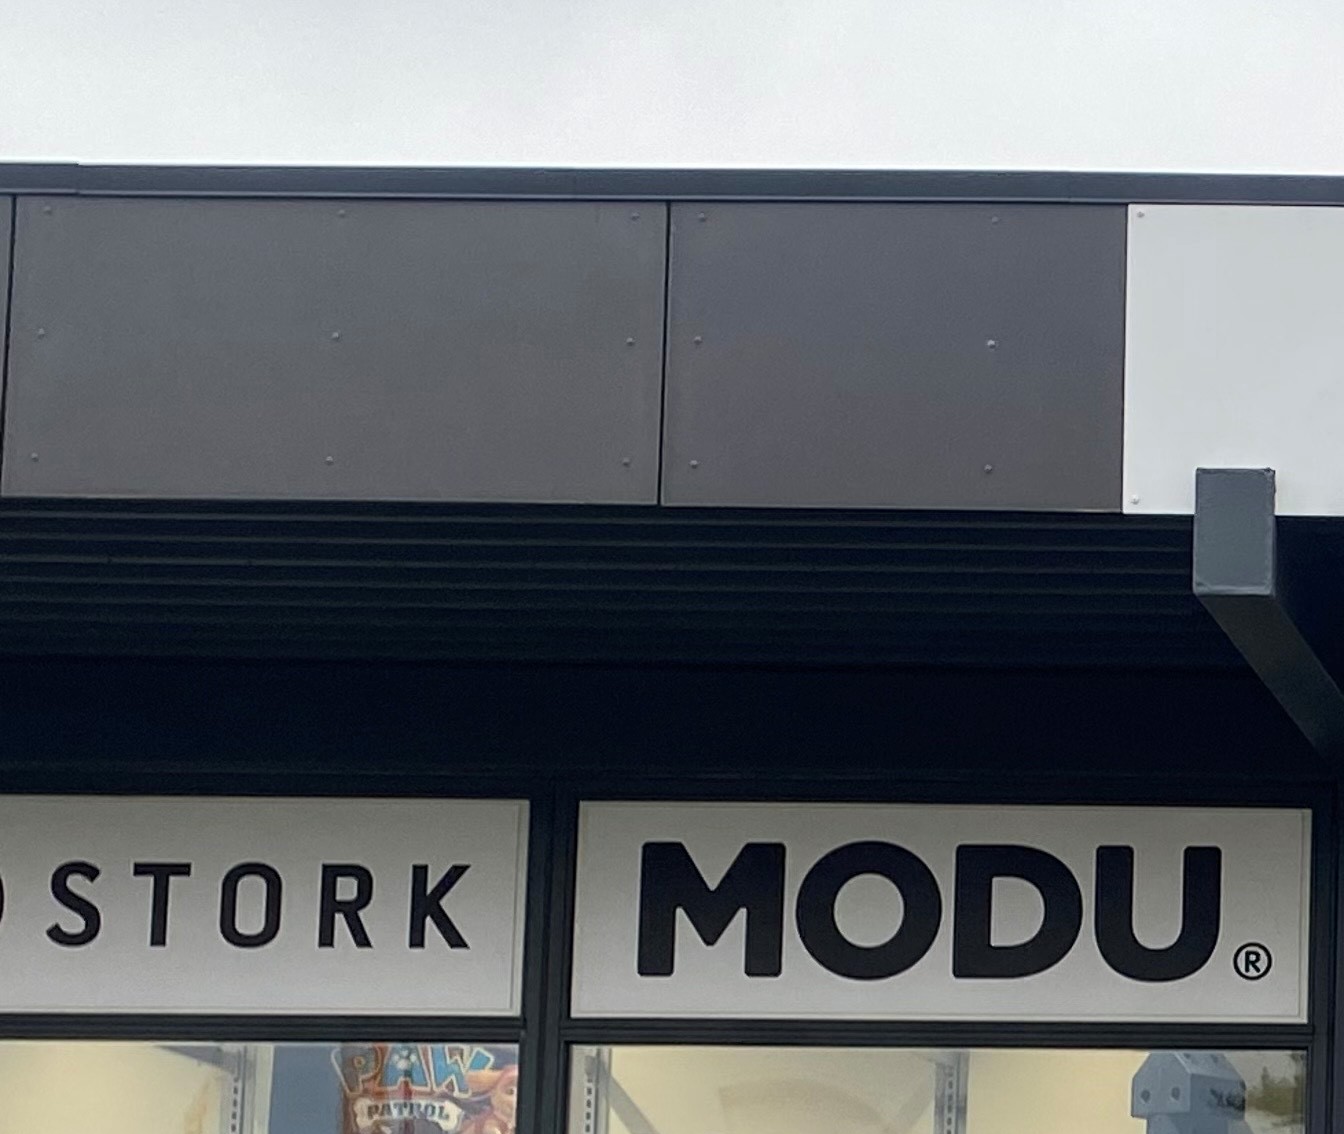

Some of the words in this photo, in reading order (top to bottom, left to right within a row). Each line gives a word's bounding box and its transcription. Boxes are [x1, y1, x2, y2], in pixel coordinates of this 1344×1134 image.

[0, 859, 472, 951] STORK
[331, 1042, 495, 1099] PAW
[366, 1101, 451, 1119] PATROL
